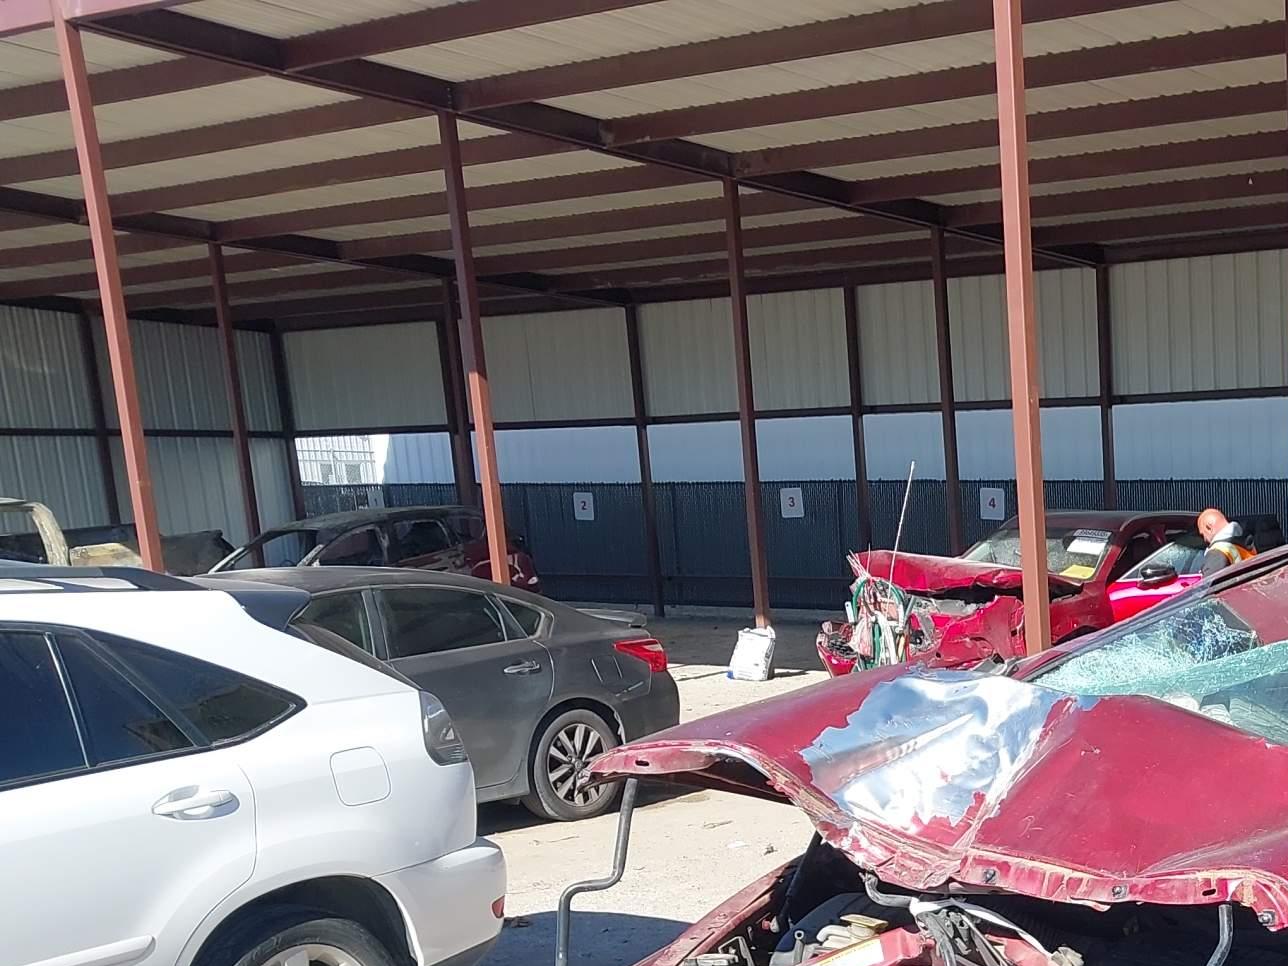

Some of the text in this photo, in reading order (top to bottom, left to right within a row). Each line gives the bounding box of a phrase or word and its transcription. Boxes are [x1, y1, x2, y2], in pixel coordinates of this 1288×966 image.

[580, 500, 588, 511] 2
[787, 496, 796, 508] 3
[987, 497, 997, 509] 4
